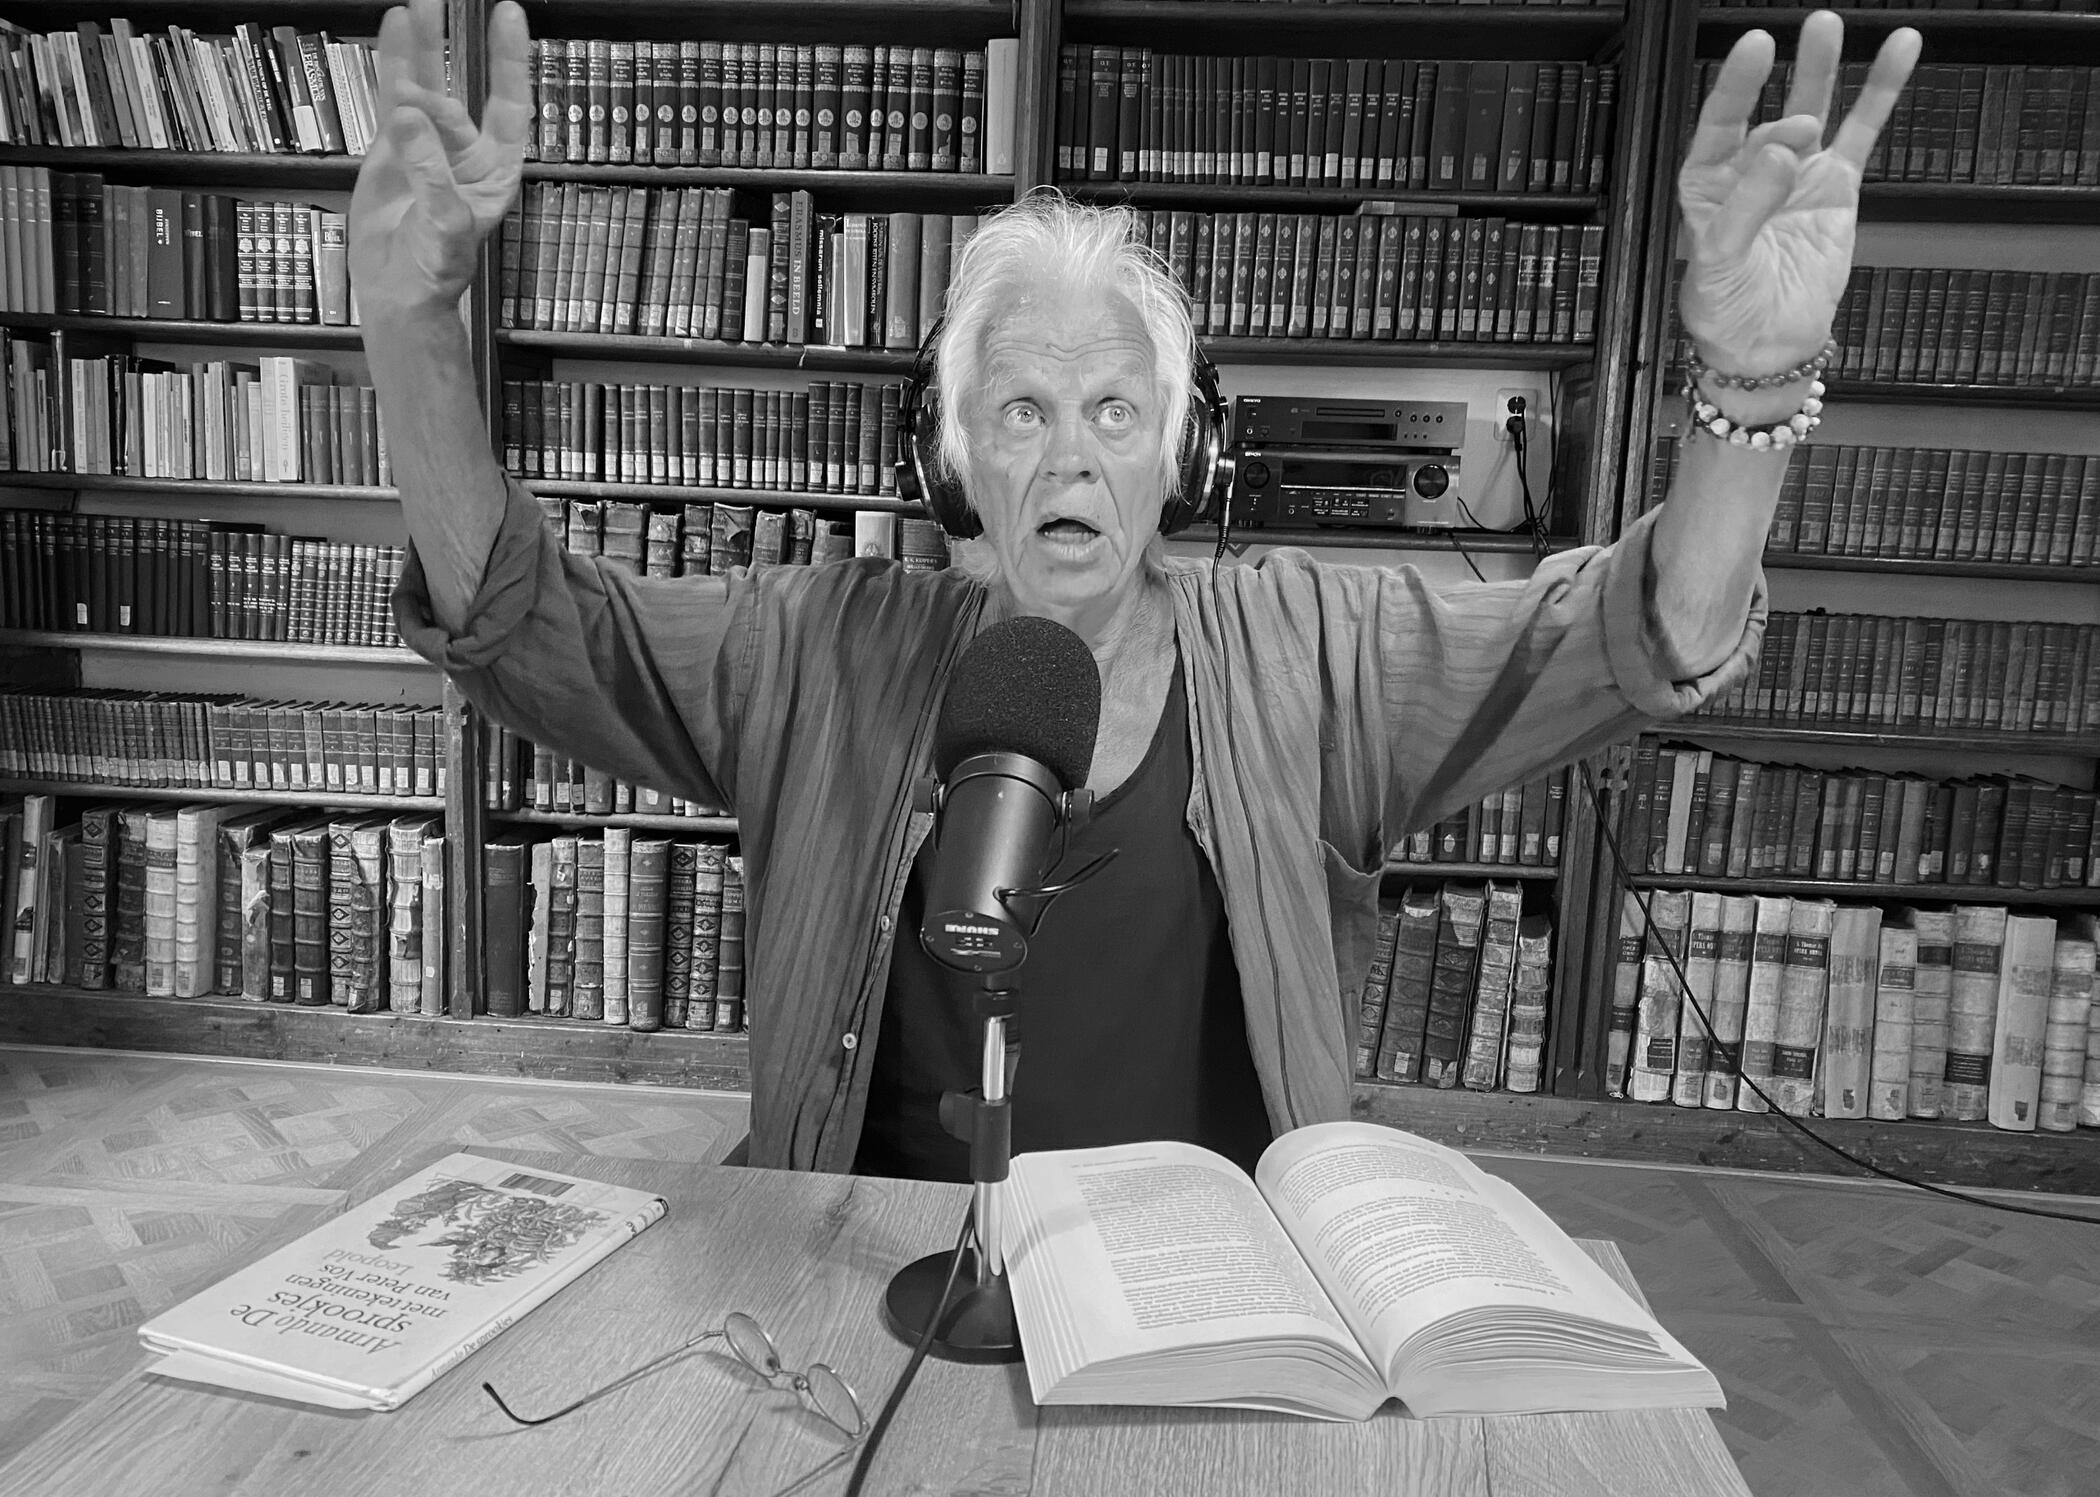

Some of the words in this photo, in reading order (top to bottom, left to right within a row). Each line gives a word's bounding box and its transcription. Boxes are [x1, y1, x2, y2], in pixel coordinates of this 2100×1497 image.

[304, 53, 320, 102] ERASMUS
[155, 209, 164, 238] BIJBEL
[795, 201, 803, 258] ERASMUS
[793, 260, 801, 273] IN
[792, 276, 801, 315] BEELD
[945, 924, 1000, 936] SHURE
[319, 1263, 355, 1281] Vos
[323, 1249, 414, 1275] Leopold
[285, 1274, 402, 1309] tekeningen
[356, 1273, 413, 1294] Peter
[414, 1286, 450, 1301] van
[230, 1304, 279, 1327] De
[267, 1291, 412, 1333] sprookjes
[402, 1302, 449, 1318] met
[275, 1314, 402, 1354] Armando
